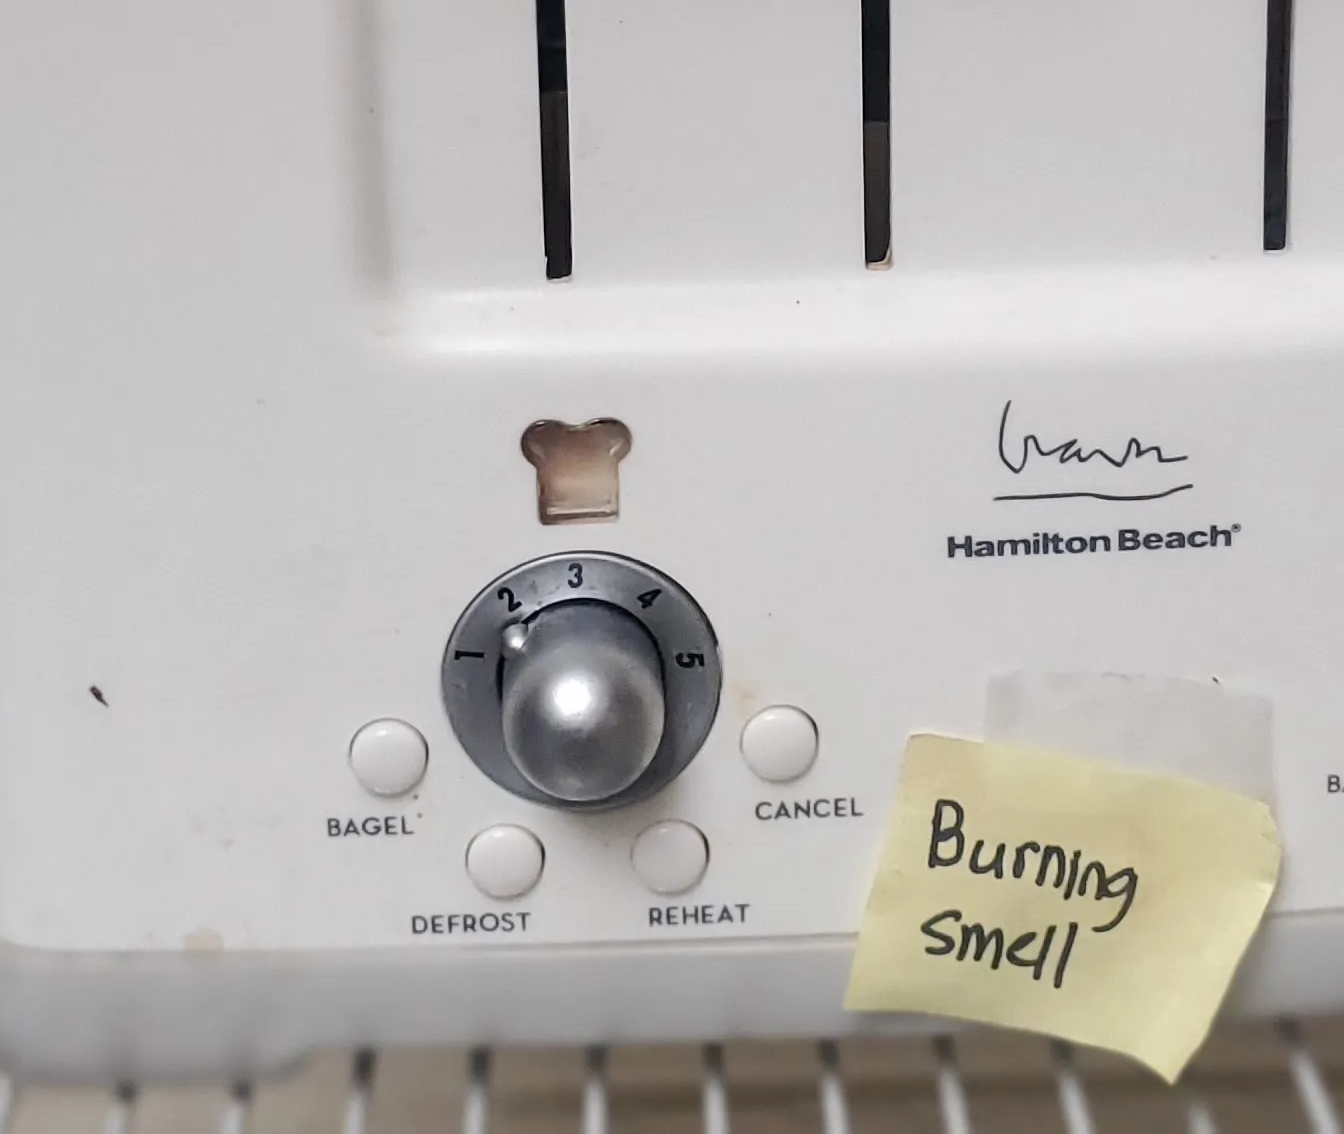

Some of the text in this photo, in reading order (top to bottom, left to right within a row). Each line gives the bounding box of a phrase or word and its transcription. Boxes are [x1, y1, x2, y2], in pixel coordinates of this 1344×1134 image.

[947, 532, 1111, 558] Hamilton
[454, 562, 705, 670] 1 2 3 4 5
[755, 797, 864, 822] CANCEL
[327, 816, 415, 839] BAGEL
[927, 798, 1139, 932] Burning
[411, 911, 531, 935] DEFROST
[648, 903, 750, 927] REHEAT
[920, 909, 1079, 989] smell
